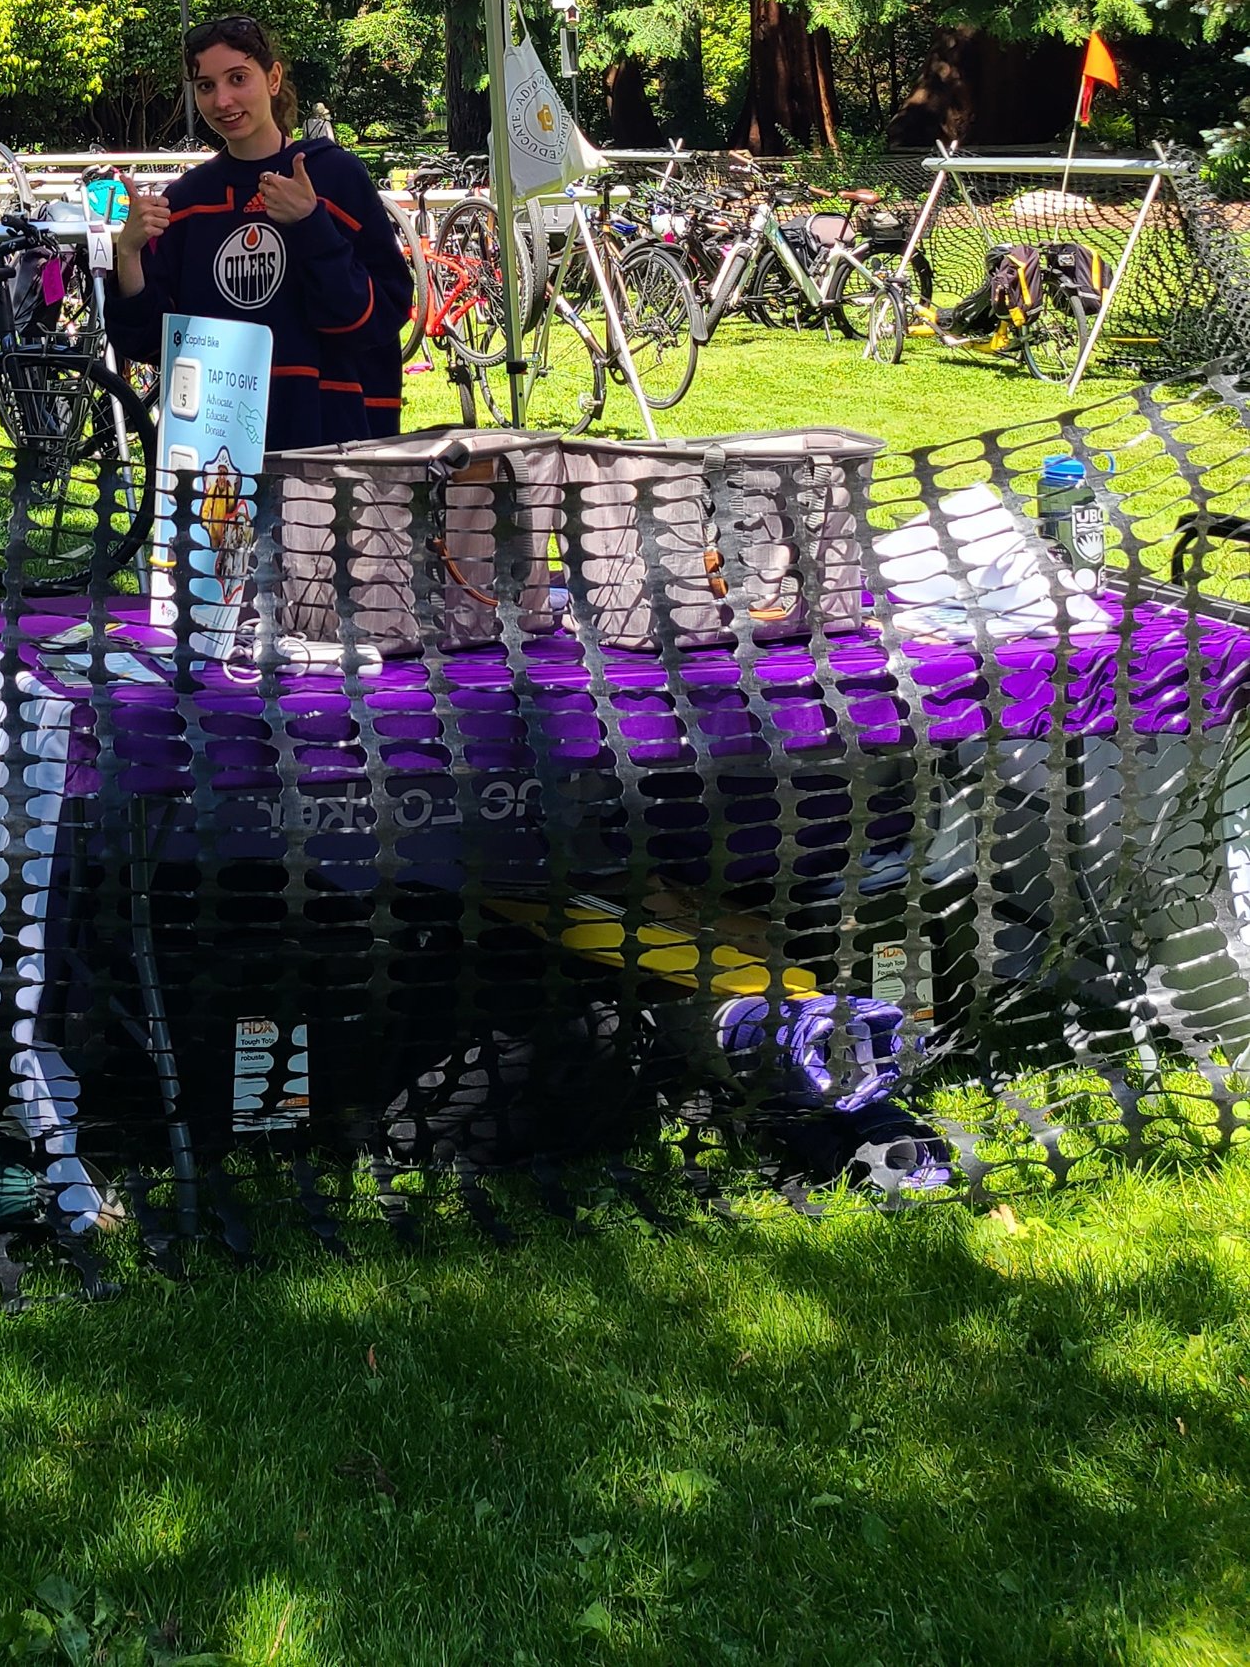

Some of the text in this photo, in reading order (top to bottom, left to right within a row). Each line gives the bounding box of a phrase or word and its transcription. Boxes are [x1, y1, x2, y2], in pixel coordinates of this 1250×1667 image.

[511, 114, 556, 160] EDUCATE
[94, 237, 108, 262] A
[224, 251, 276, 301] OILERS
[184, 334, 207, 347] Capital
[207, 336, 220, 348] Bike
[208, 368, 258, 391] TAP TO GIVE
[240, 1038, 261, 1047] Tough
